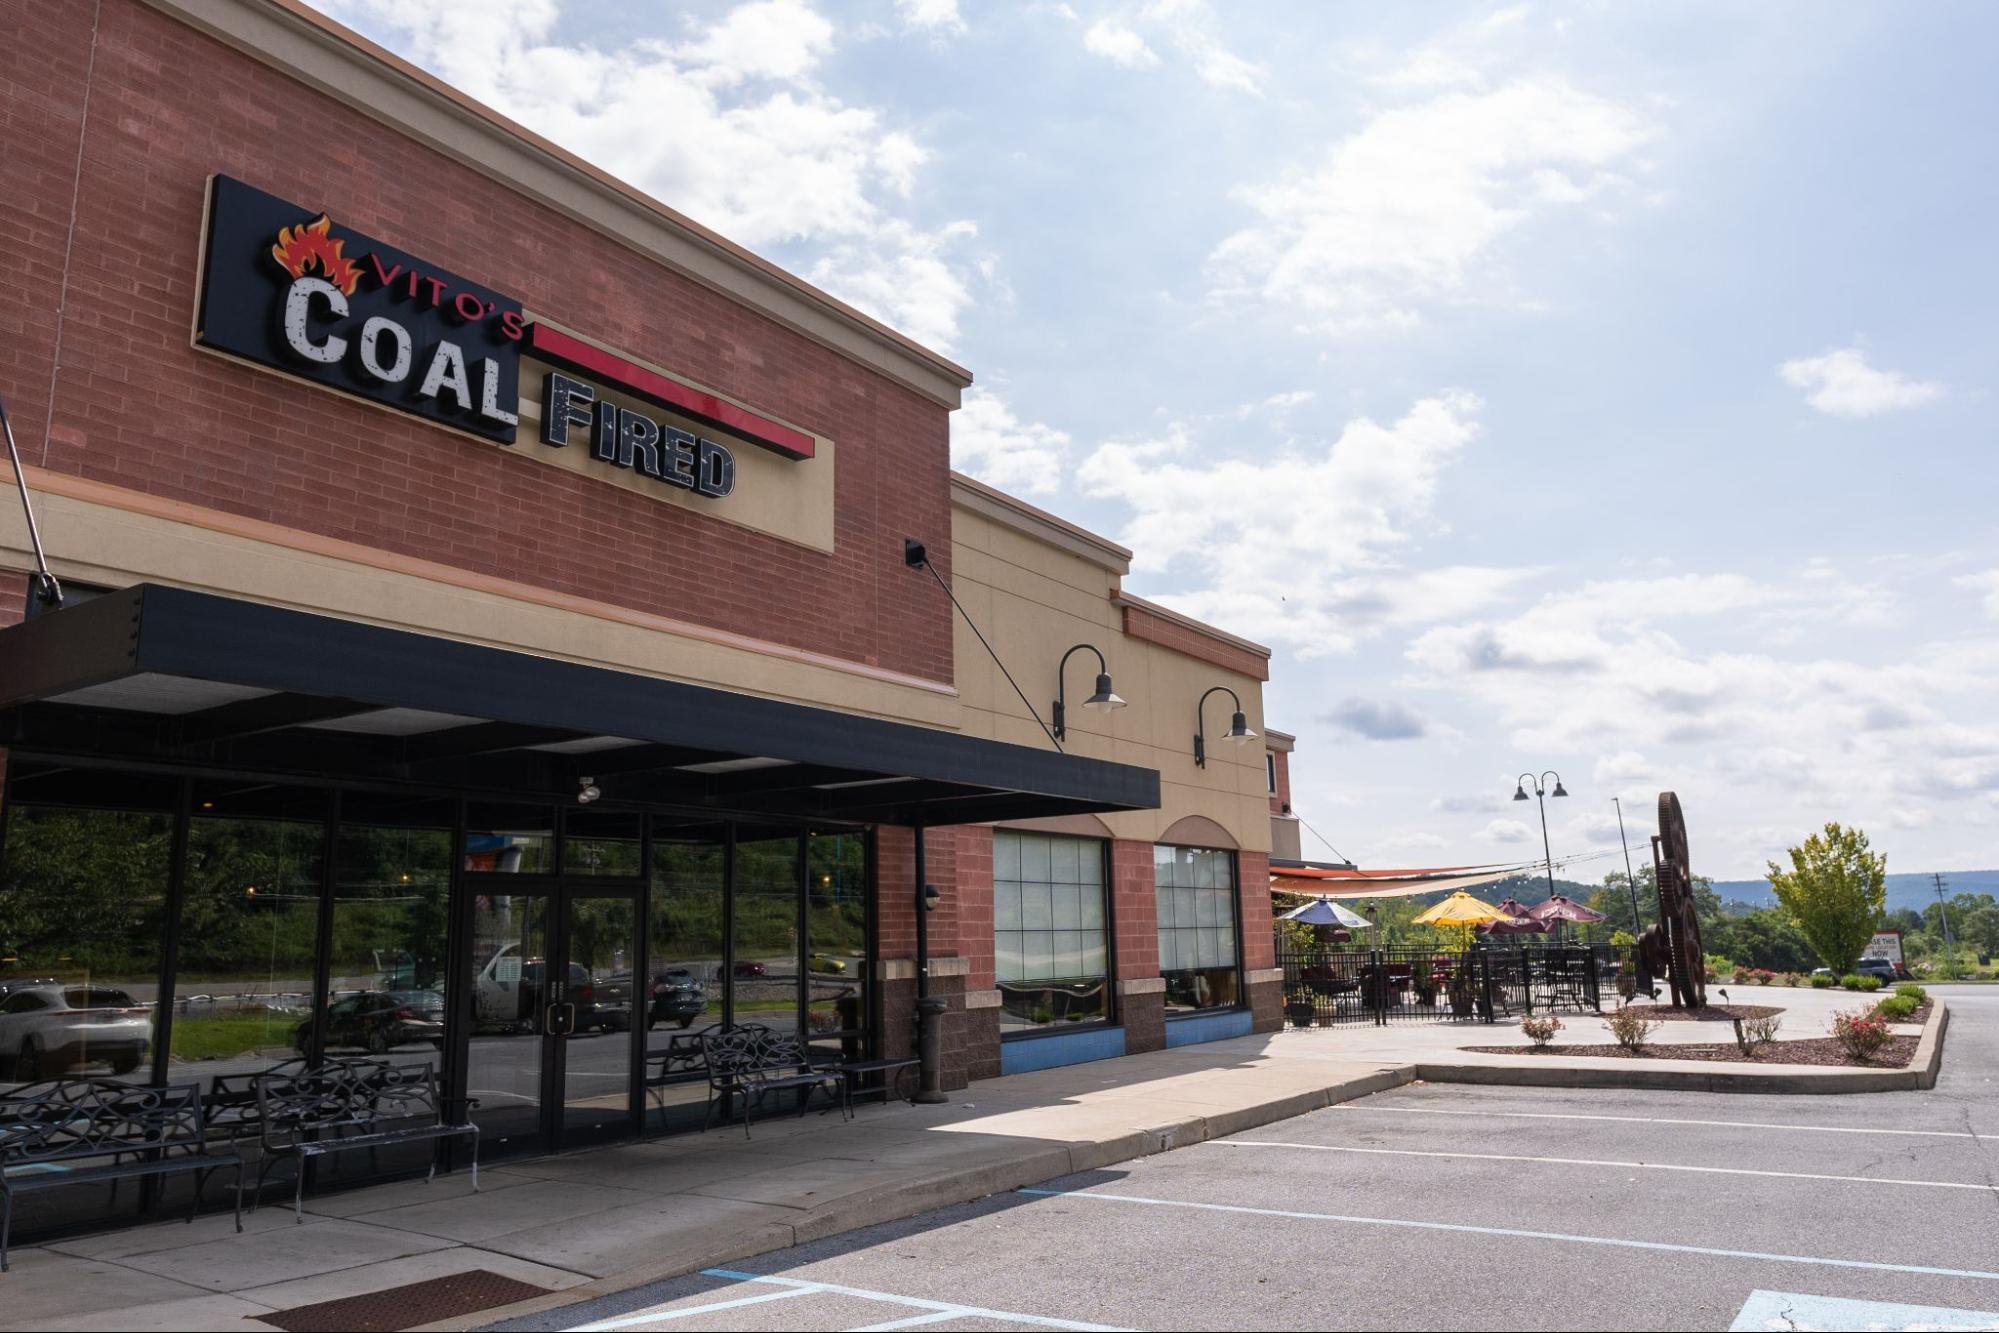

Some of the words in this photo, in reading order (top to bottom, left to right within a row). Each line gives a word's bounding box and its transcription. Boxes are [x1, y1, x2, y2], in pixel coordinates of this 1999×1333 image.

[284, 276, 519, 425] COAL
[371, 253, 525, 341] VITO'S
[548, 371, 736, 498] FIRED
